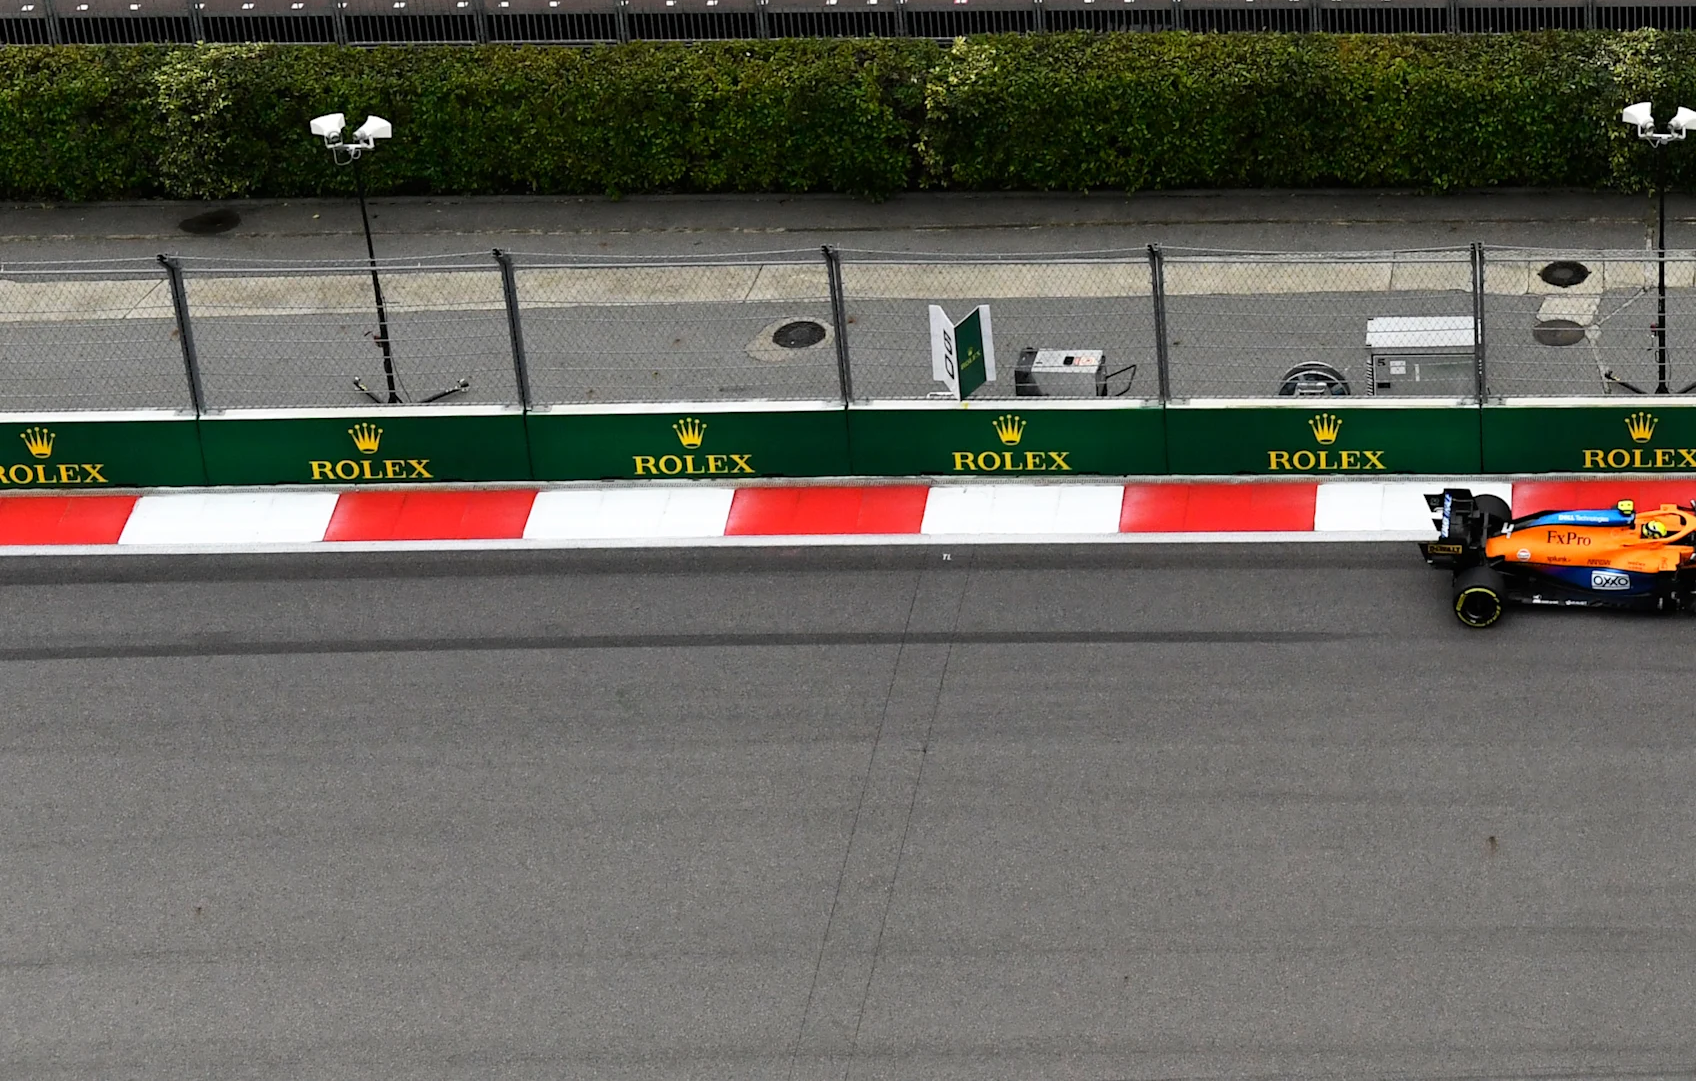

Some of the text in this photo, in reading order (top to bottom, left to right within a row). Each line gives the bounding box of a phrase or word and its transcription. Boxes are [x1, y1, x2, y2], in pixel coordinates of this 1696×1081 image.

[311, 459, 433, 480] ROLEX
[634, 454, 754, 475] ROLEX
[953, 451, 1070, 471] ROLEX
[1269, 450, 1385, 470] ROLEX
[0, 463, 109, 484] ROLEX
[1501, 522, 1515, 539] 4
[1546, 530, 1592, 547] FxPro
[1593, 574, 1629, 588] OXXO
